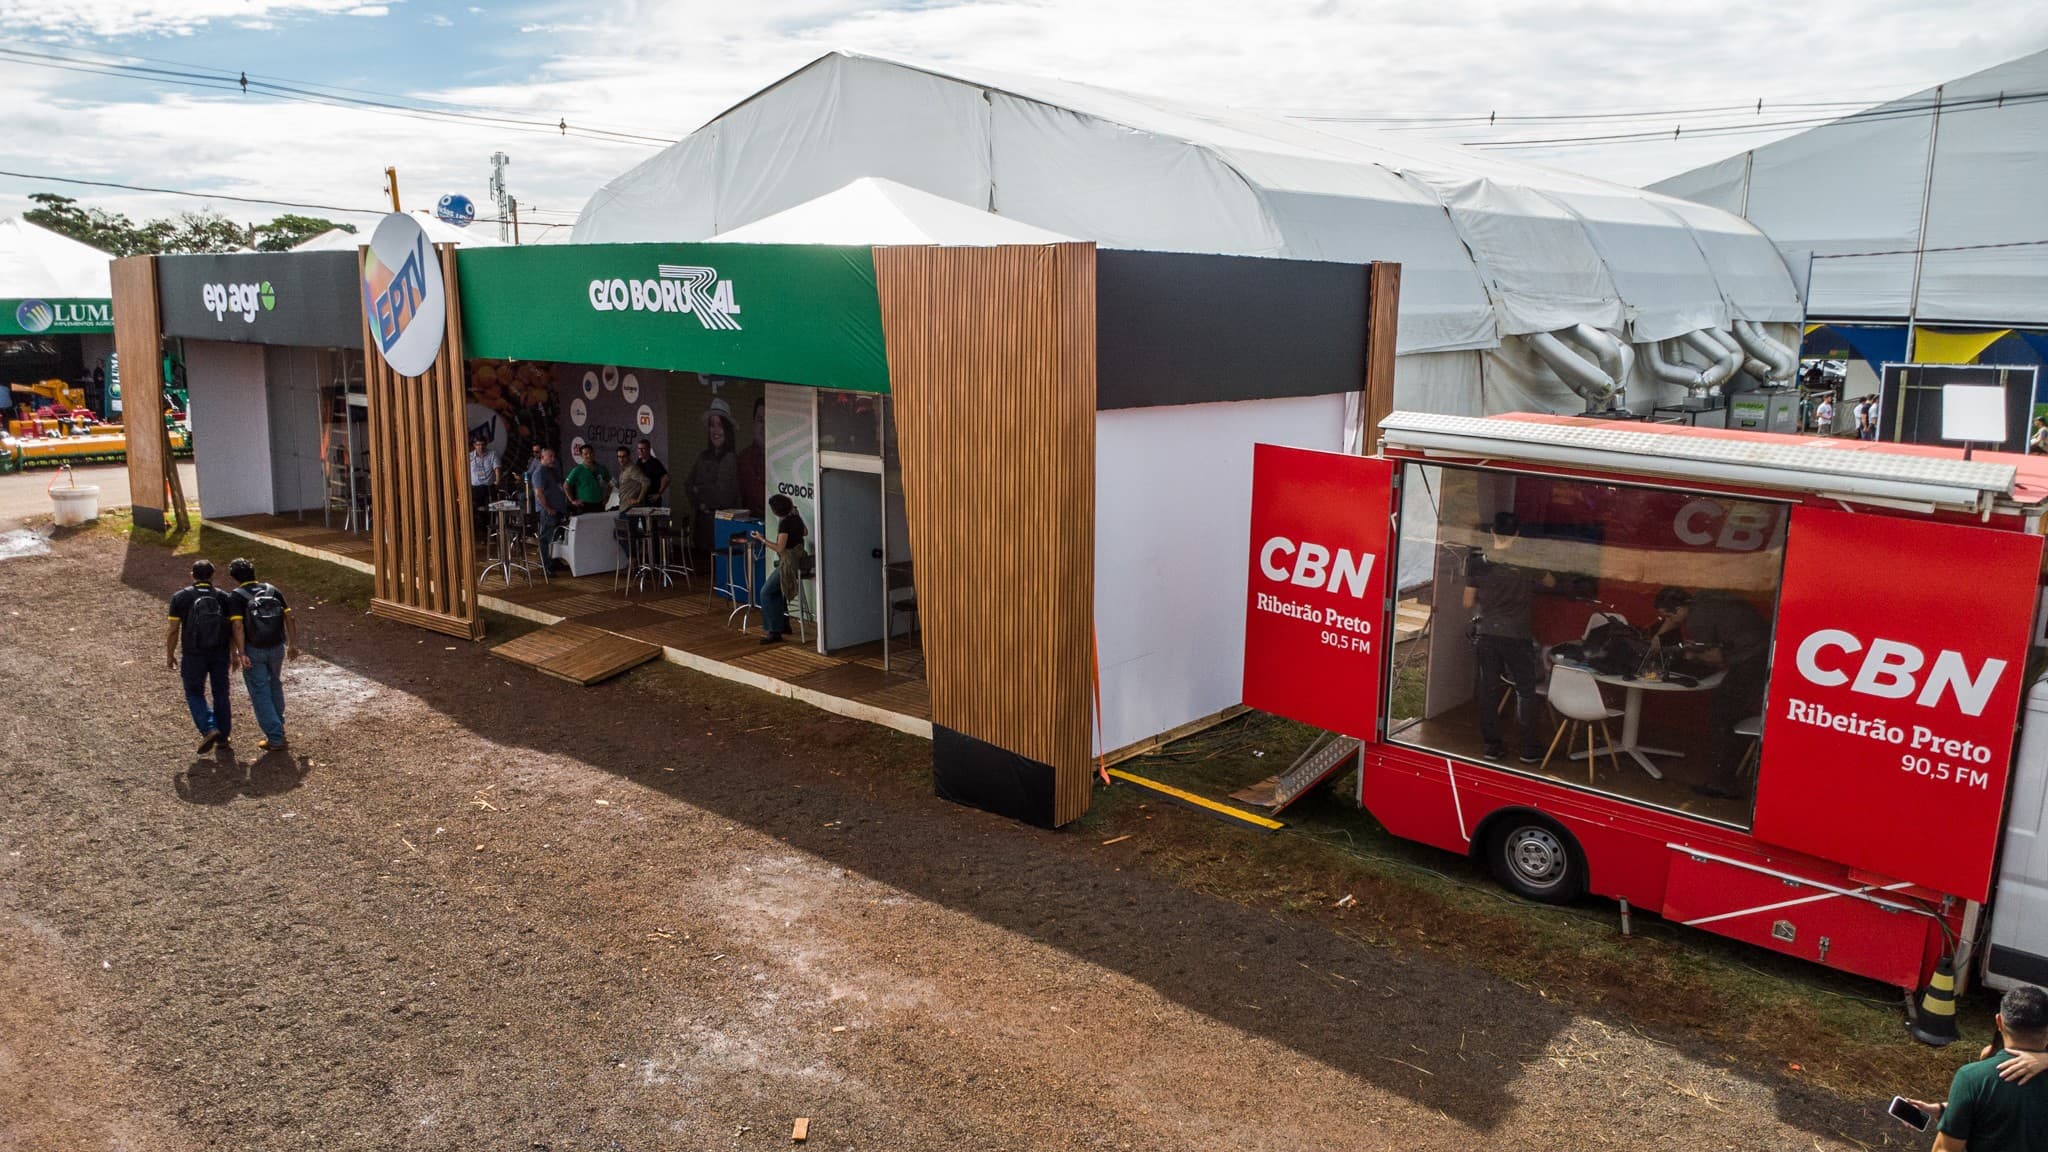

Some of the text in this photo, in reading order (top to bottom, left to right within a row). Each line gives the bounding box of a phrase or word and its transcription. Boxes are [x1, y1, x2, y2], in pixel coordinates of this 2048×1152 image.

[53, 304, 114, 322] LUM
[376, 229, 426, 354] EPTV
[1260, 536, 1376, 599] CBN
[1257, 592, 1371, 635] Ribeirão Preto
[1321, 631, 1371, 655] 90,5 FM
[1796, 628, 2008, 717] CBN
[1786, 698, 1991, 764] Ribeirão Preto
[1901, 754, 1989, 790] 90,5 FM
